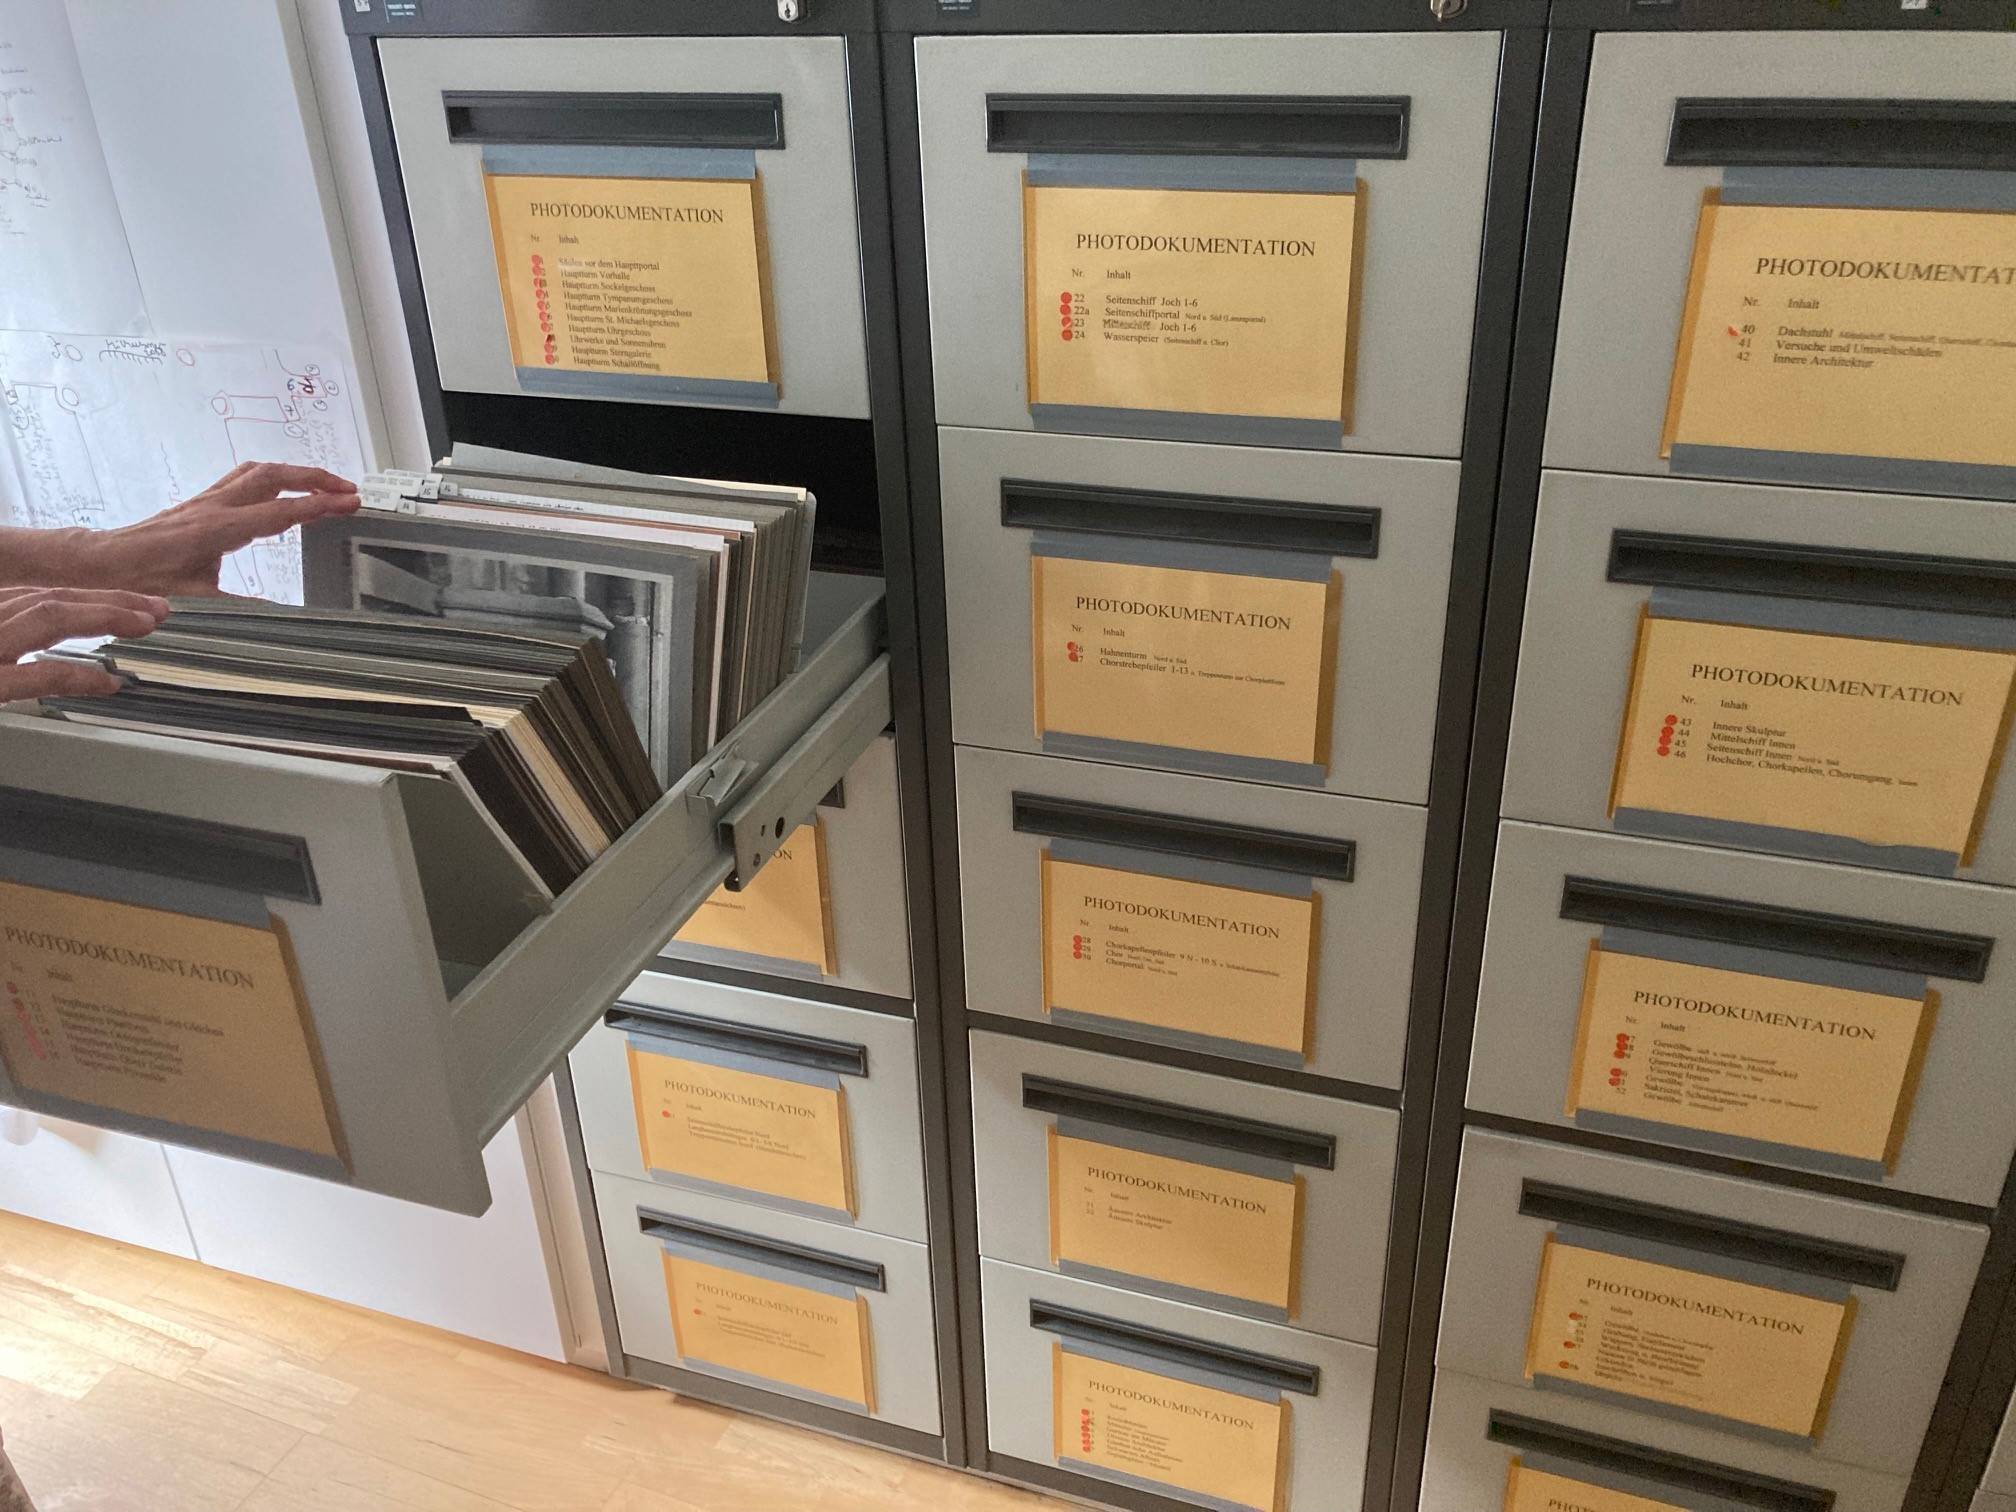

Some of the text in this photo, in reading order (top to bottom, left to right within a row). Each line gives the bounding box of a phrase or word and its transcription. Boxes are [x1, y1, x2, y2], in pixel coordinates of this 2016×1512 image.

[530, 202, 724, 223] PHOTODOKUMENTATION
[1077, 233, 1316, 257] PHOTODOKUMENTATION
[597, 259, 613, 269] dem
[1755, 257, 2016, 285] PHOTODOKUMENTAT
[560, 270, 598, 280] Hauptturm
[600, 271, 630, 281] Vorhalle
[1106, 270, 1131, 280] Inhalt
[562, 280, 600, 290] Hauptturm
[1073, 294, 1199, 308] 22 Seitenschiff Joch 1-6
[1787, 298, 1820, 310] Inhalt
[1073, 306, 1090, 316] 22a
[1104, 307, 1180, 321] Seitenschiffportal
[1074, 319, 1085, 328] 23
[1160, 322, 1181, 332] Joch
[1183, 322, 1197, 333] 1-6
[1778, 325, 1834, 338] Dachstuhl
[605, 336, 619, 346] und
[1074, 331, 1086, 340] 24
[1104, 332, 1159, 345] Wasserspeier
[1776, 339, 1827, 353] Versuche
[1830, 342, 1850, 354] und
[1736, 352, 1874, 368] 42 Innere Architektur
[1076, 596, 1291, 631] PHOTODOKUMENTATION
[1103, 627, 1125, 638] Inhalt
[1100, 647, 1147, 660] Hahnenturm
[1100, 657, 1167, 673] Chorstrebepfeiler
[1691, 663, 1963, 707] PHOTODOKUMENTATION
[1720, 698, 1749, 712] Inhalt
[1680, 718, 1787, 737] 43 Innere Skulptur
[1678, 729, 1796, 750] 44 Mittelschiff Innen
[1674, 749, 1687, 759] 46
[1675, 739, 1687, 748] 45
[1706, 743, 1764, 757] Seitenschiff
[1765, 749, 1793, 761] Innen
[1084, 896, 1280, 939] PHOTODOKUMENTATION
[1108, 924, 1129, 934] Inhalt
[4, 926, 254, 989] PHOTODOKUMENTATION
[1634, 990, 1878, 1041] PHOTODOKUMENTATION
[1660, 1022, 1686, 1033] Inhalt
[664, 1079, 817, 1119] PHOTODOKUMENTATION
[1087, 1166, 1267, 1215] PHOTODOKUMENTATION
[695, 1282, 839, 1326] PHOTODOKUMENTATION
[1587, 1278, 1806, 1336] PHOTODOKUMENTATION
[1088, 1380, 1255, 1431] PHOTODOKUMENTATION
